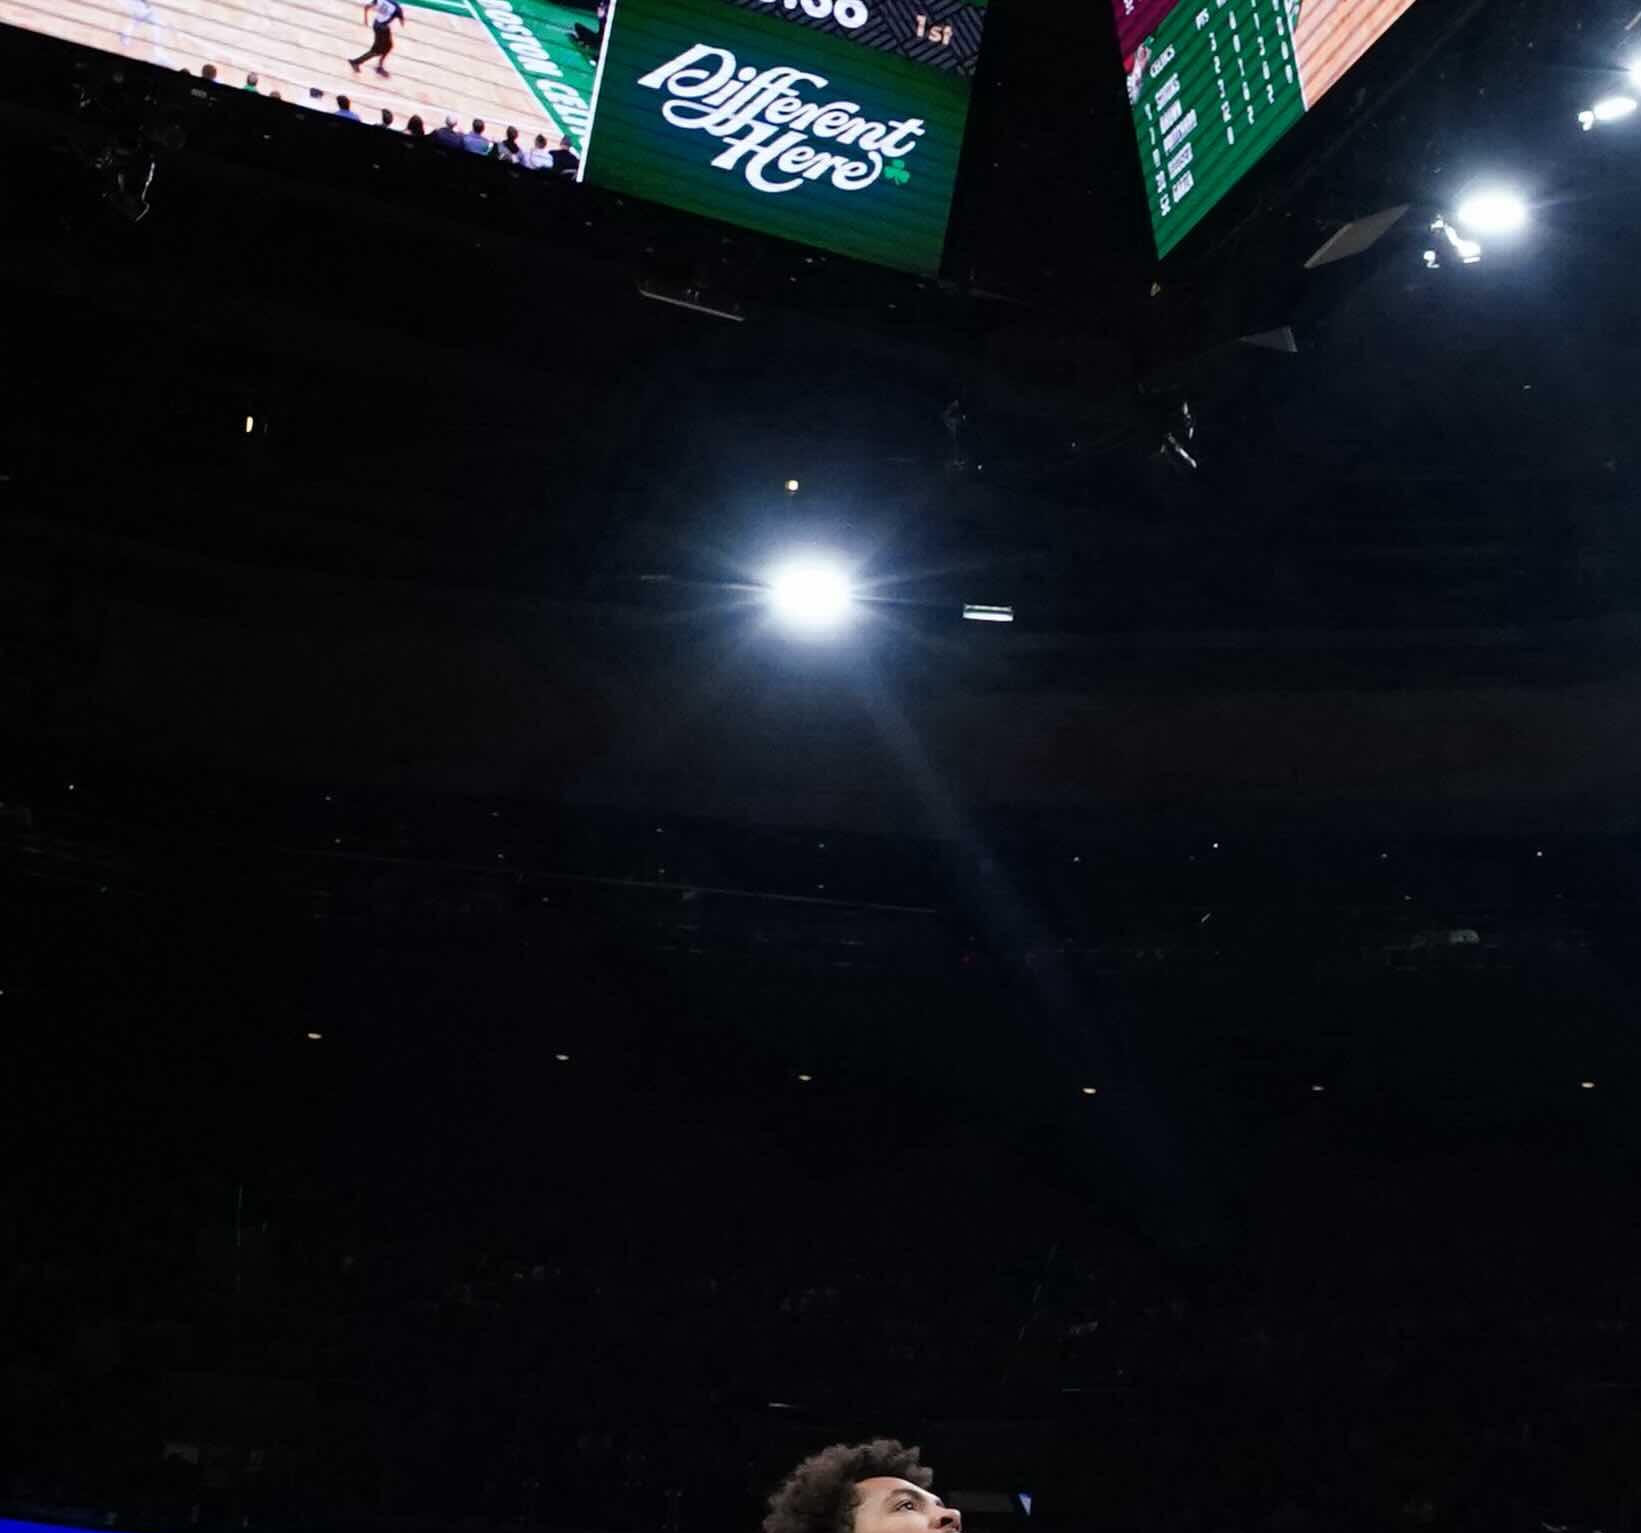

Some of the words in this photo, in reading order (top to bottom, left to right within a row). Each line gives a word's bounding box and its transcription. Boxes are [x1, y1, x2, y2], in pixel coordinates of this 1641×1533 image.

[915, 15, 953, 46] 1st
[637, 43, 925, 157] Different
[673, 102, 883, 192] Here
